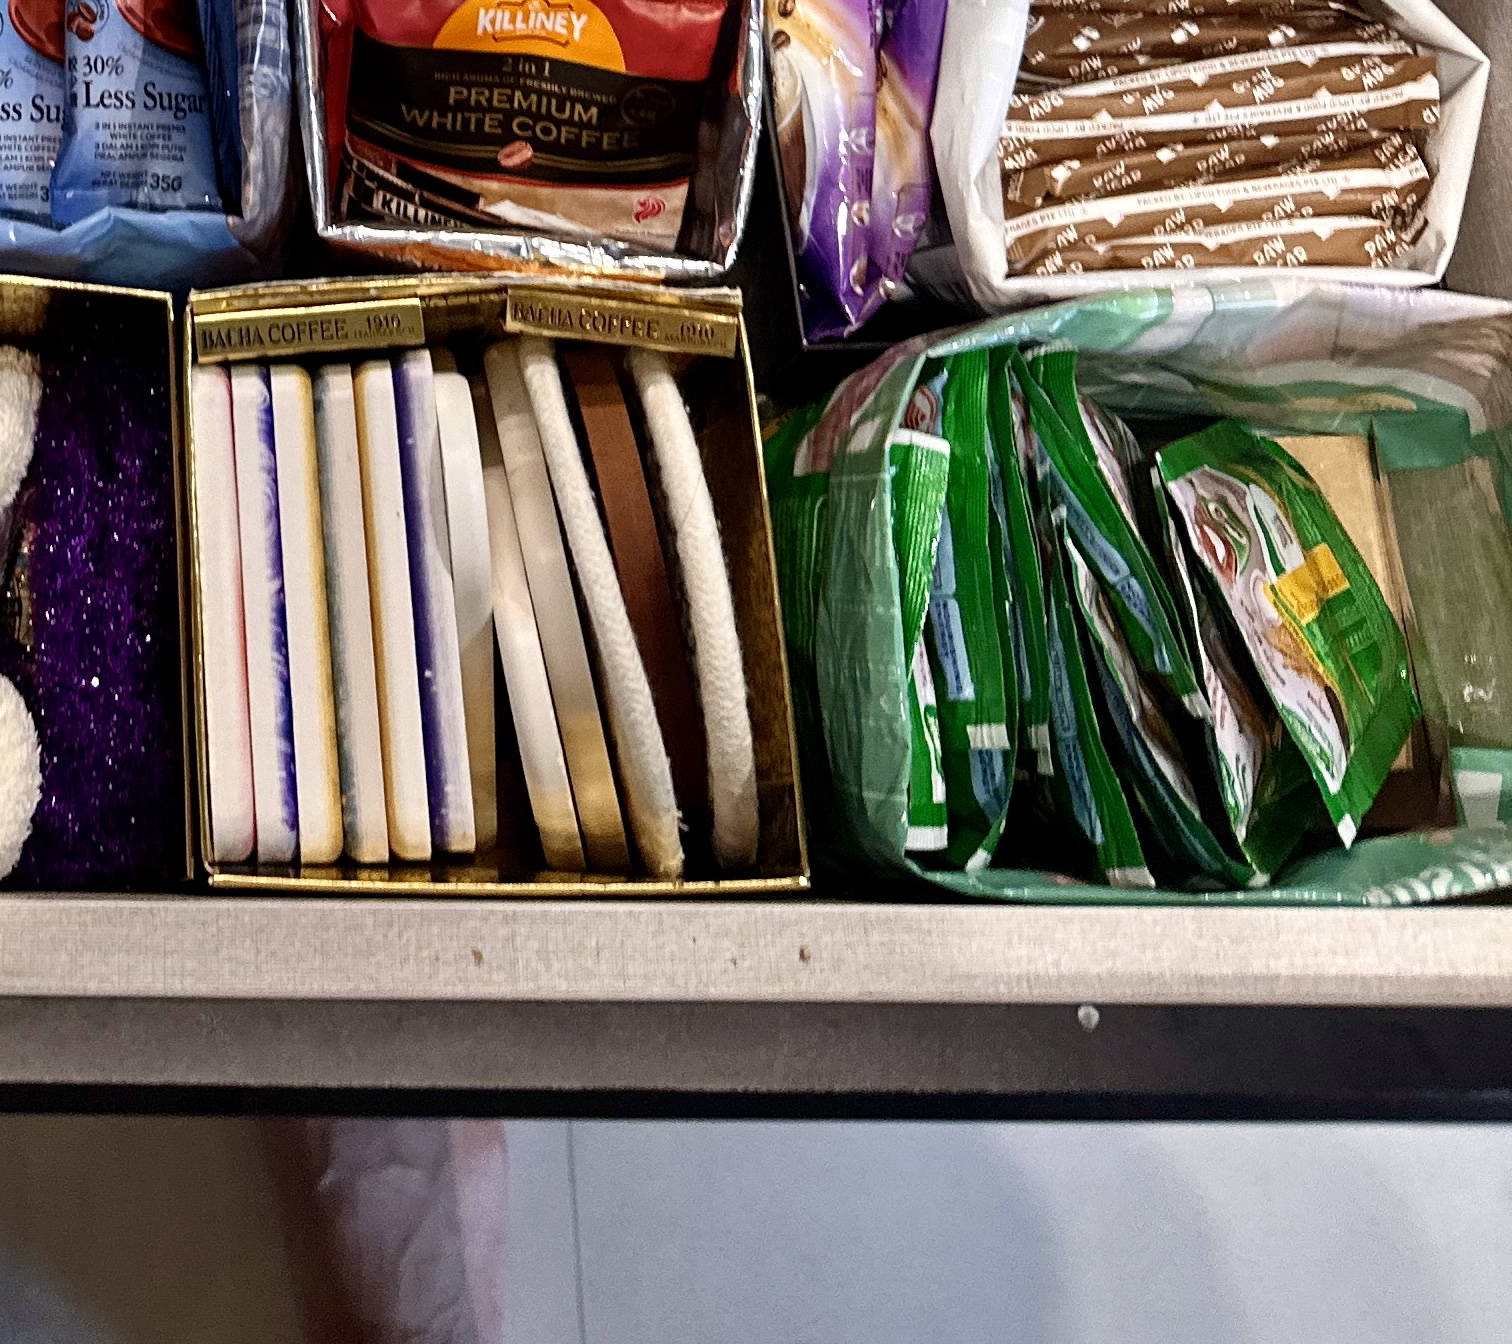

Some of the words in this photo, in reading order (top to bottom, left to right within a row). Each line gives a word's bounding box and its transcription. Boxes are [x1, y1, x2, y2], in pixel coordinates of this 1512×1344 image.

[476, 6, 589, 42] KILLINEY
[82, 53, 125, 78] 30%
[30, 93, 65, 130] Su
[82, 80, 136, 110] Less
[143, 80, 205, 120] Sugar
[448, 85, 598, 127] PREMIUM
[400, 102, 504, 135] WHITE
[511, 115, 639, 152] COFFEE
[267, 317, 348, 344] COFFEE
[365, 313, 402, 330] 1910
[578, 308, 660, 340] COFFEE
